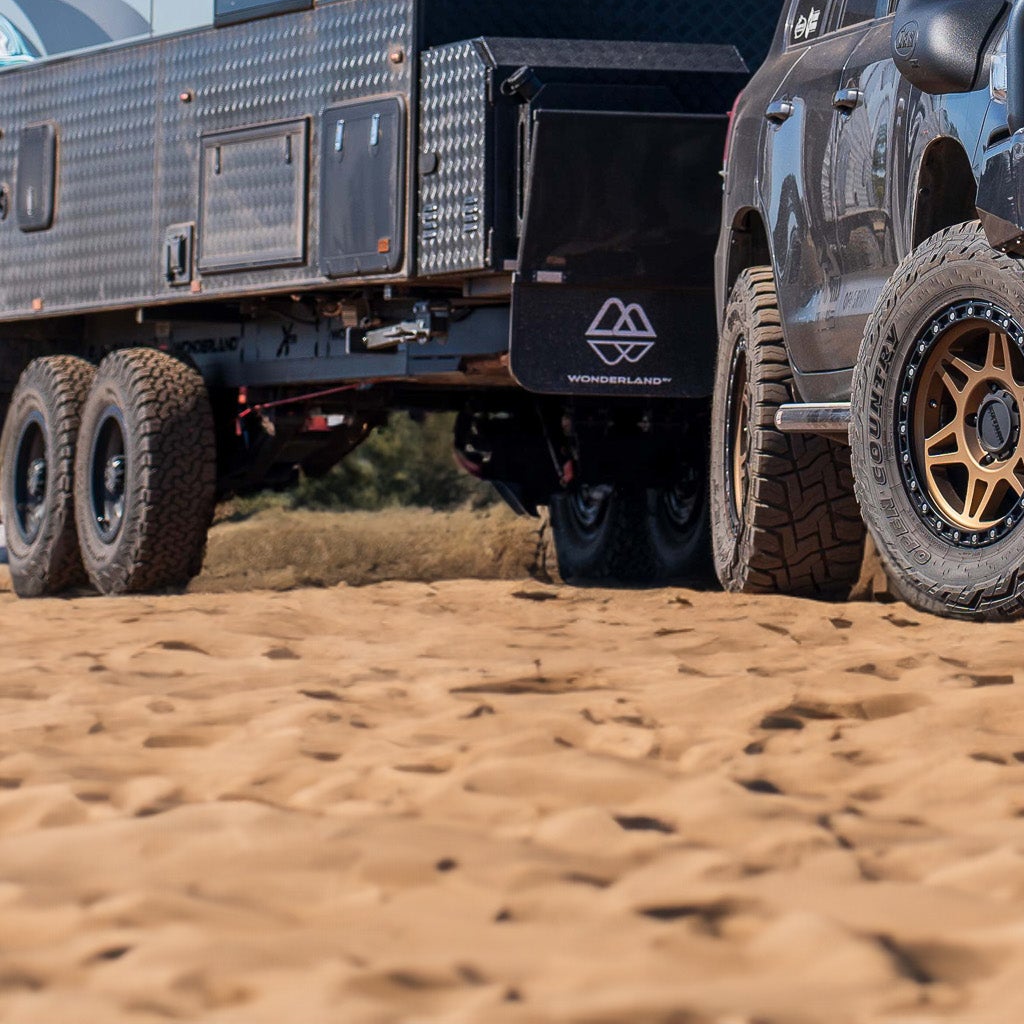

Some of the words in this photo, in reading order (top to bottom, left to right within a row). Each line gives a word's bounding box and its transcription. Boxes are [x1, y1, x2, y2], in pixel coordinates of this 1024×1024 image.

[567, 375, 662, 385] WONDERLAND
[867, 326, 900, 486] COUNTRY
[880, 496, 932, 567] OPEN
